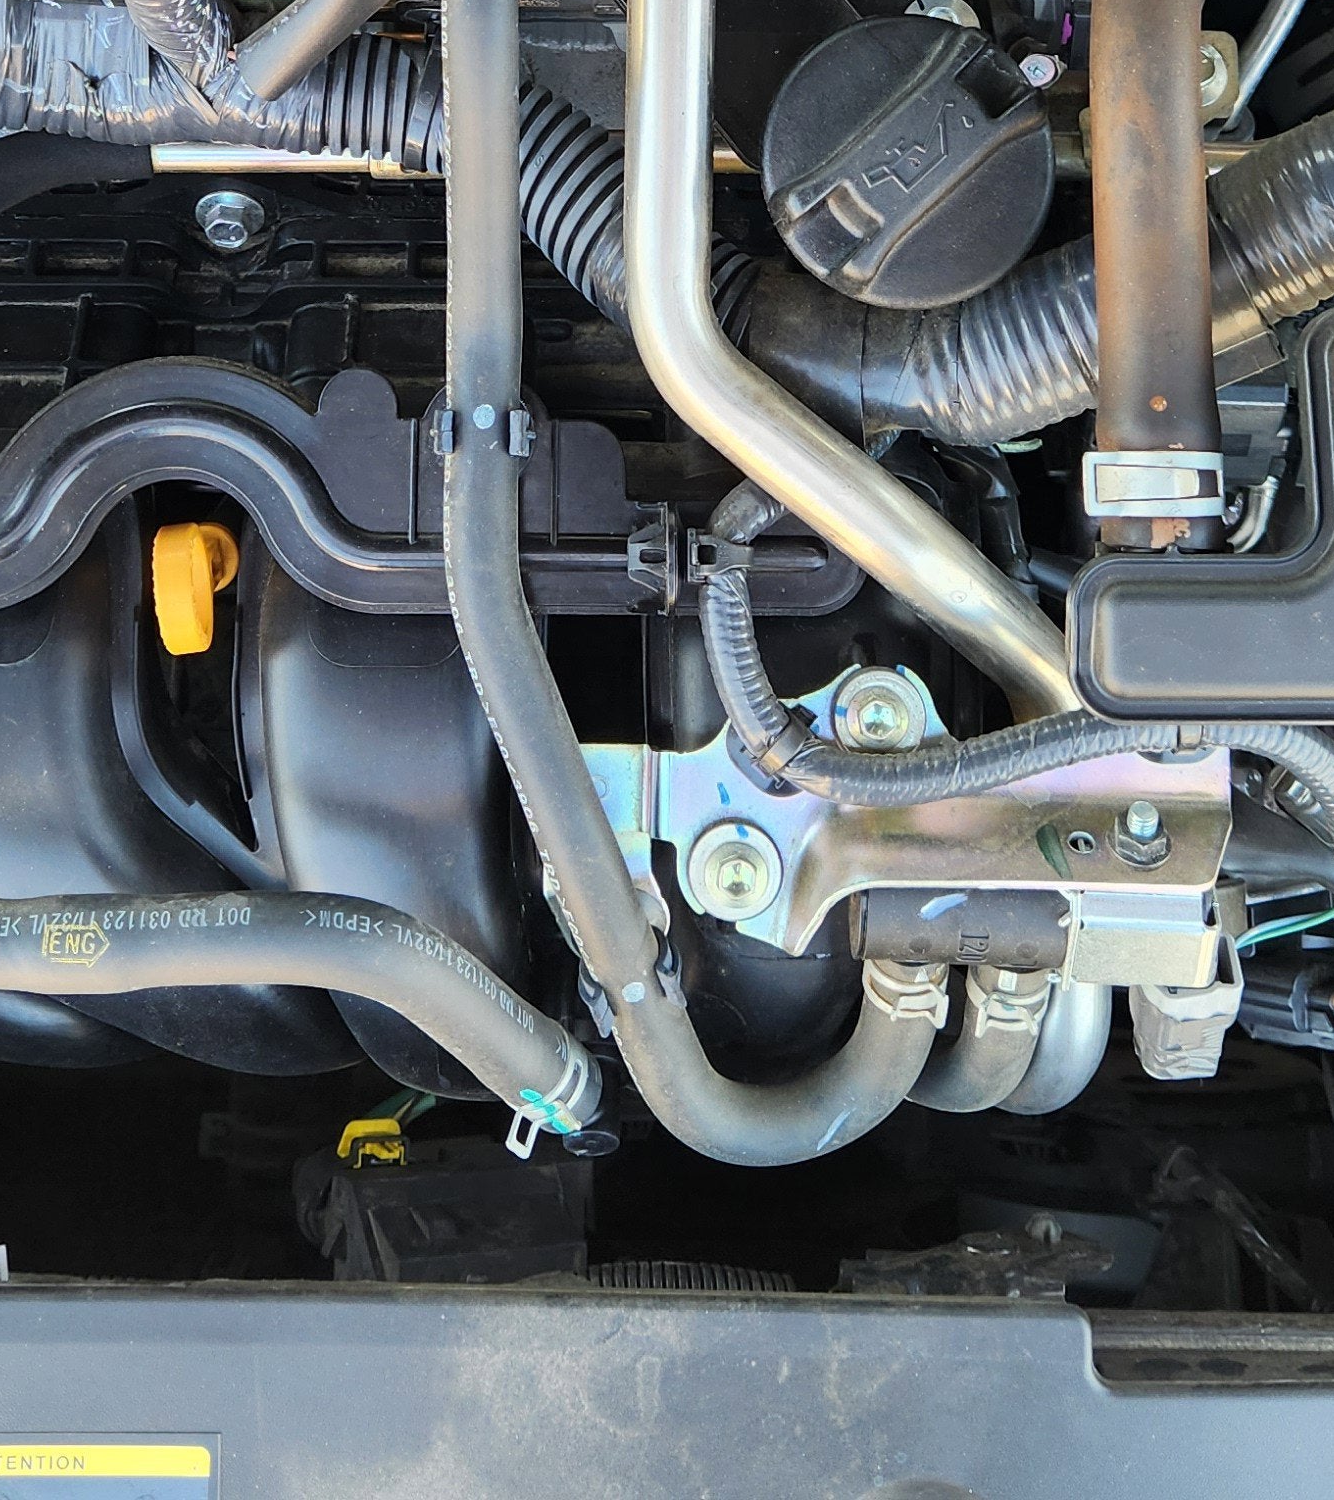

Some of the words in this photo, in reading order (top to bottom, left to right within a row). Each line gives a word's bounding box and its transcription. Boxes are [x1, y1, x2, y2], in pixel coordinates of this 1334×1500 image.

[101, 908, 172, 932] 031123
[214, 905, 251, 928] DOT
[304, 907, 385, 939] >EPDM<
[48, 931, 97, 955] ENG
[514, 1007, 536, 1035] DOT
